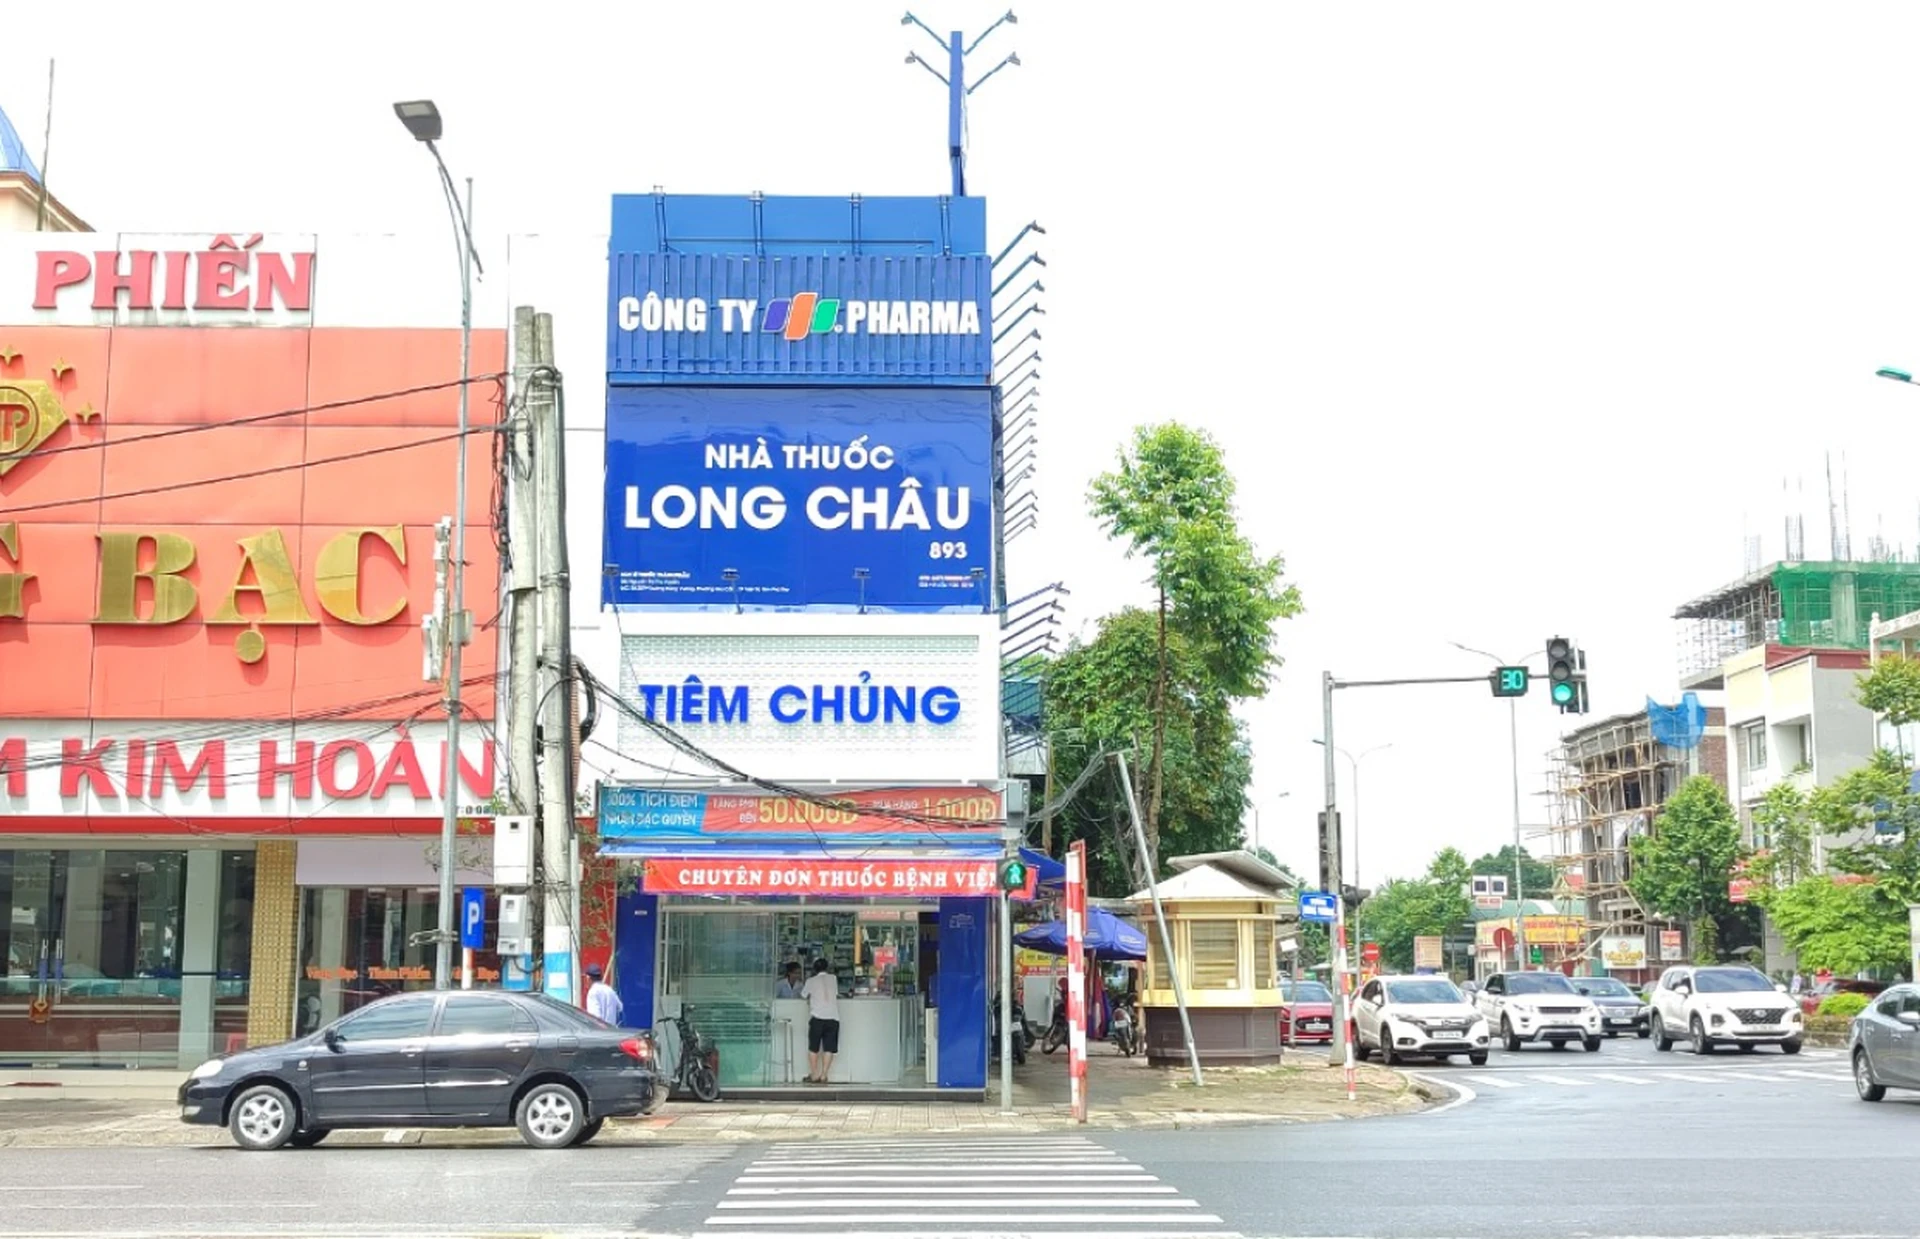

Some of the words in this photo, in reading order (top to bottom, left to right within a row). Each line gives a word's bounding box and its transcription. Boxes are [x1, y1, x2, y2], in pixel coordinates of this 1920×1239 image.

[32, 233, 316, 310] PHIẾN
[618, 291, 707, 332] CÔNG
[718, 299, 758, 332] TY
[846, 300, 981, 334] PHARMA
[704, 437, 773, 469] NHÀ
[782, 434, 894, 469] THUỐC
[624, 485, 787, 530] LONG
[806, 477, 970, 530] CHÂU
[929, 541, 967, 559] 893
[90, 524, 408, 664] BẠC
[638, 674, 749, 723] TIÊM
[769, 670, 961, 725] CHỦNG
[1502, 670, 1523, 689] 30
[60, 738, 226, 798] KIM
[257, 722, 494, 799] HOÀN
[678, 866, 762, 886] CHUYÊN
[768, 867, 811, 886] ĐƠN
[818, 864, 888, 887] THUỐC
[892, 866, 948, 891] BỆNH
[467, 902, 481, 935] P
